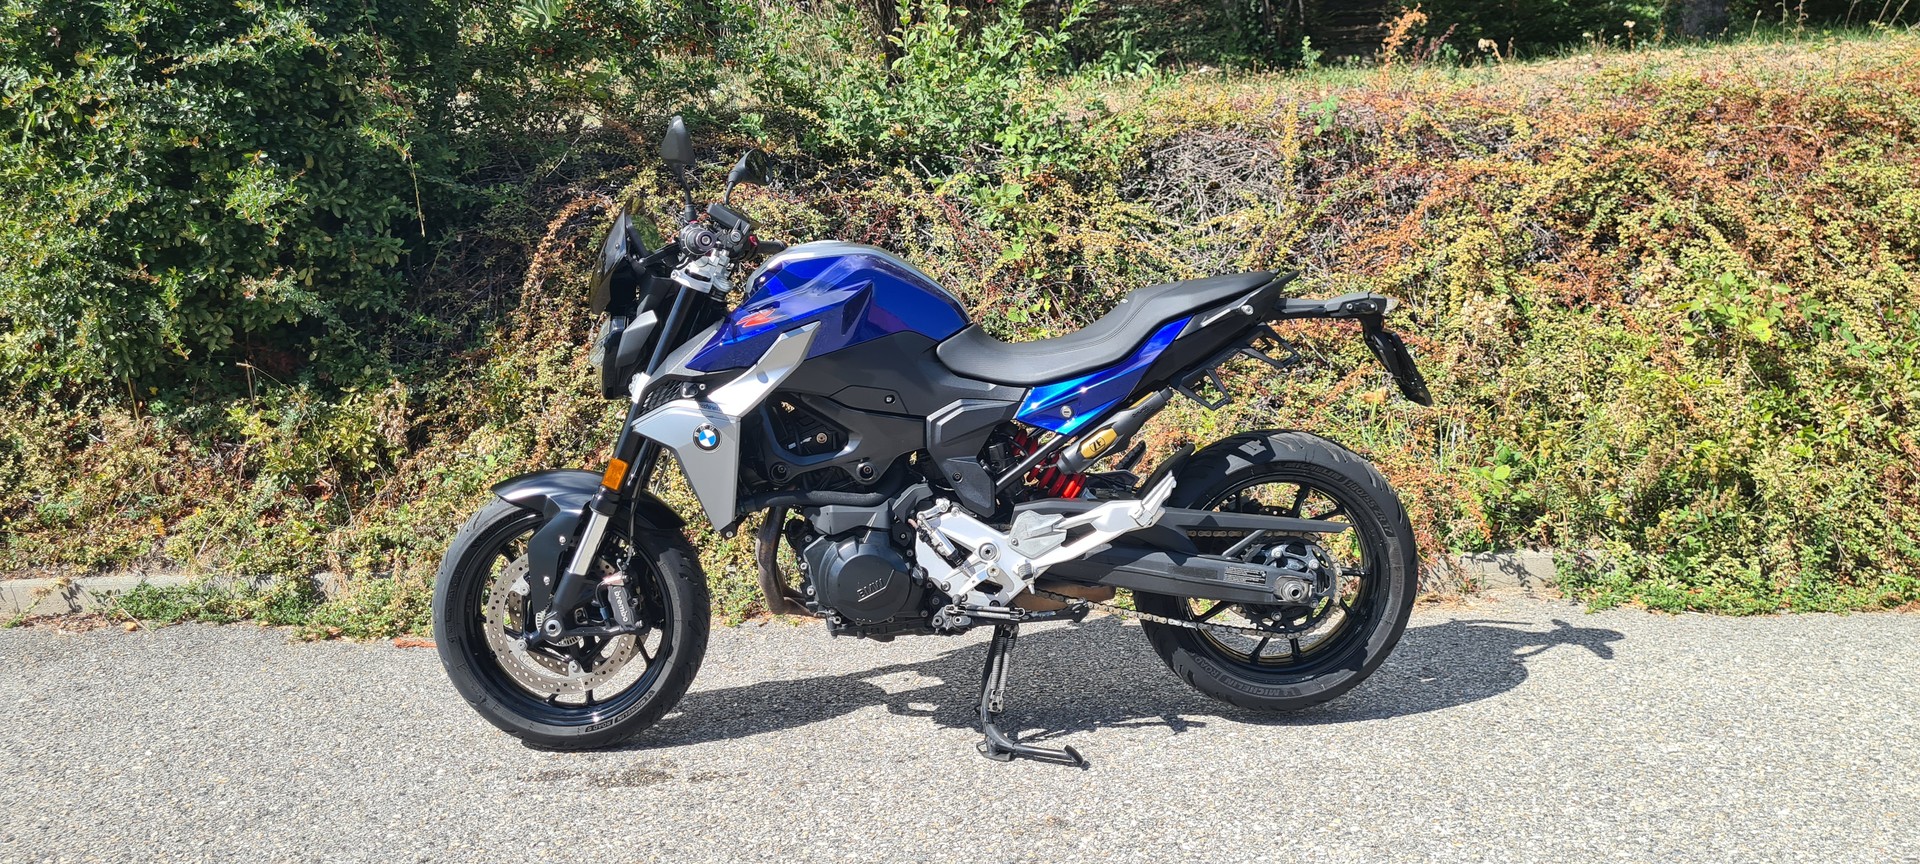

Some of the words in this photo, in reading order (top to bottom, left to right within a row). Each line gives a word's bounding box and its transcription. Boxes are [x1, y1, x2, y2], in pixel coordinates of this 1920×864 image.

[1089, 436, 1106, 452] ZF
[1285, 461, 1341, 480] MICHELIN
[1373, 507, 1386, 521] ZR
[1382, 521, 1392, 534] 17
[856, 577, 885, 599] BMW
[613, 590, 629, 622] brembo
[1193, 655, 1219, 677] ROAD
[1223, 677, 1279, 696] MICHELIN
[616, 697, 647, 720] MICHELIN
[592, 720, 612, 730] ROAD
